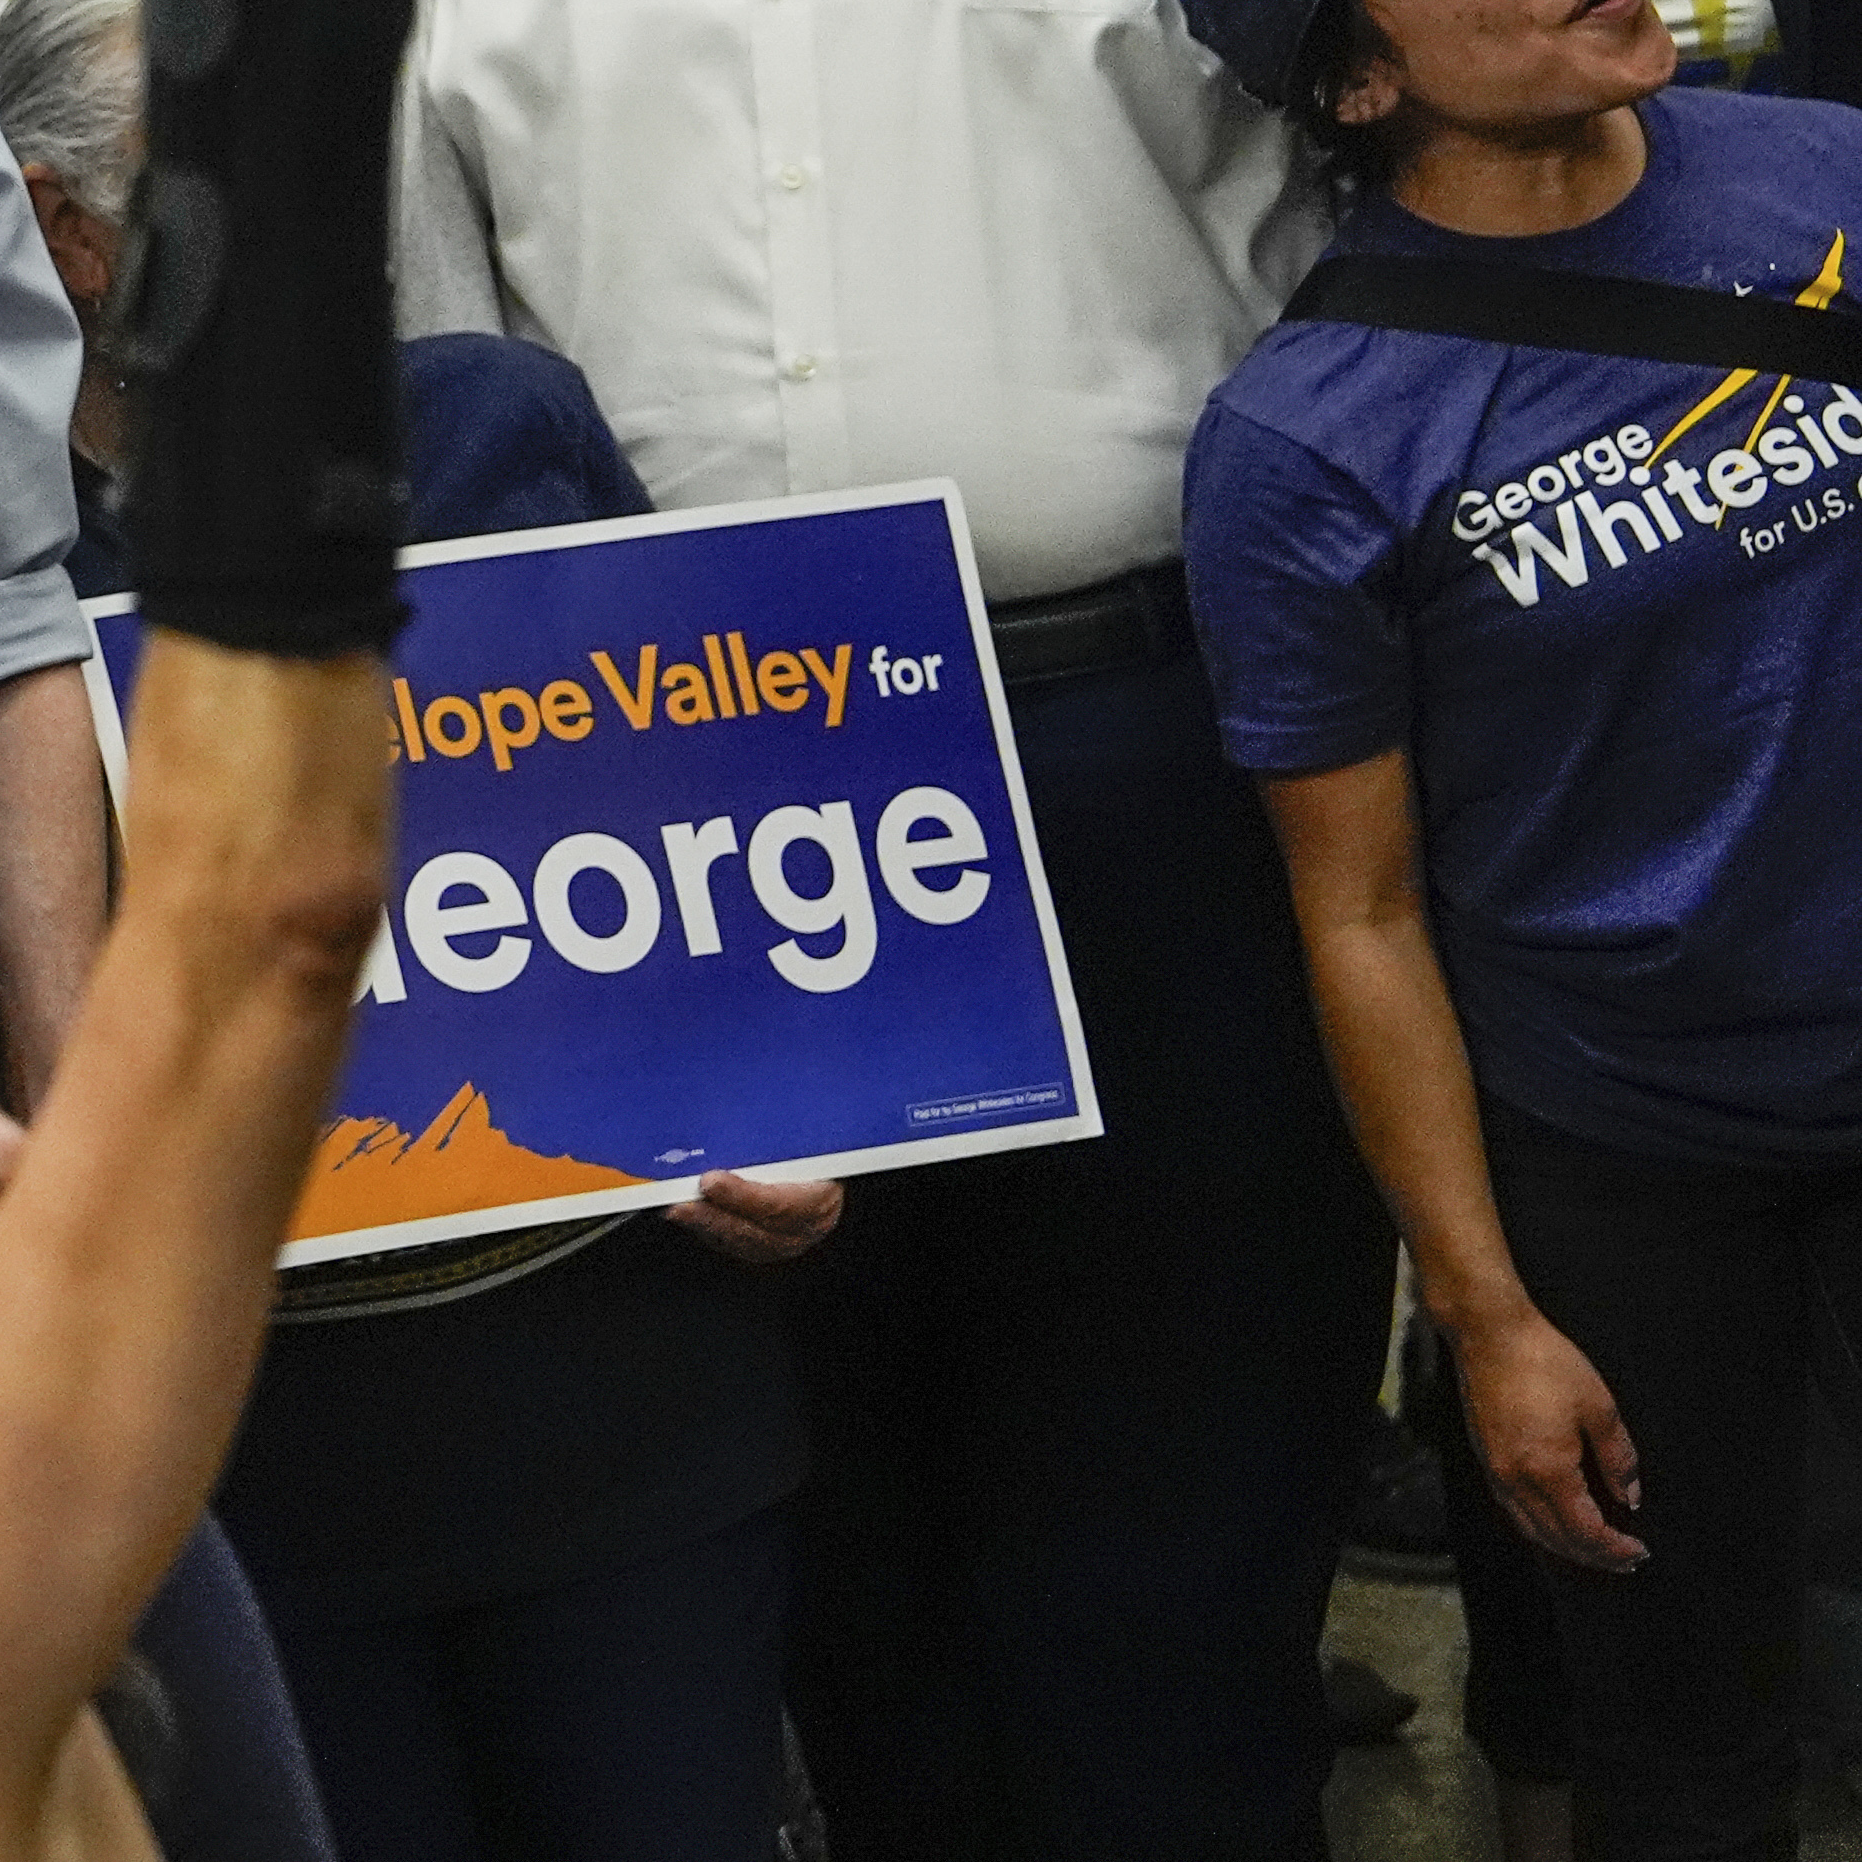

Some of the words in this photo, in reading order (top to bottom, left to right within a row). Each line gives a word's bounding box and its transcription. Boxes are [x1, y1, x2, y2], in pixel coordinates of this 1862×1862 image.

[1452, 423, 1654, 542] George
[1739, 520, 1786, 559] for
[1791, 487, 1855, 534] U.S.
[388, 674, 594, 771] lope
[591, 630, 853, 728] Valley
[867, 645, 944, 699] for
